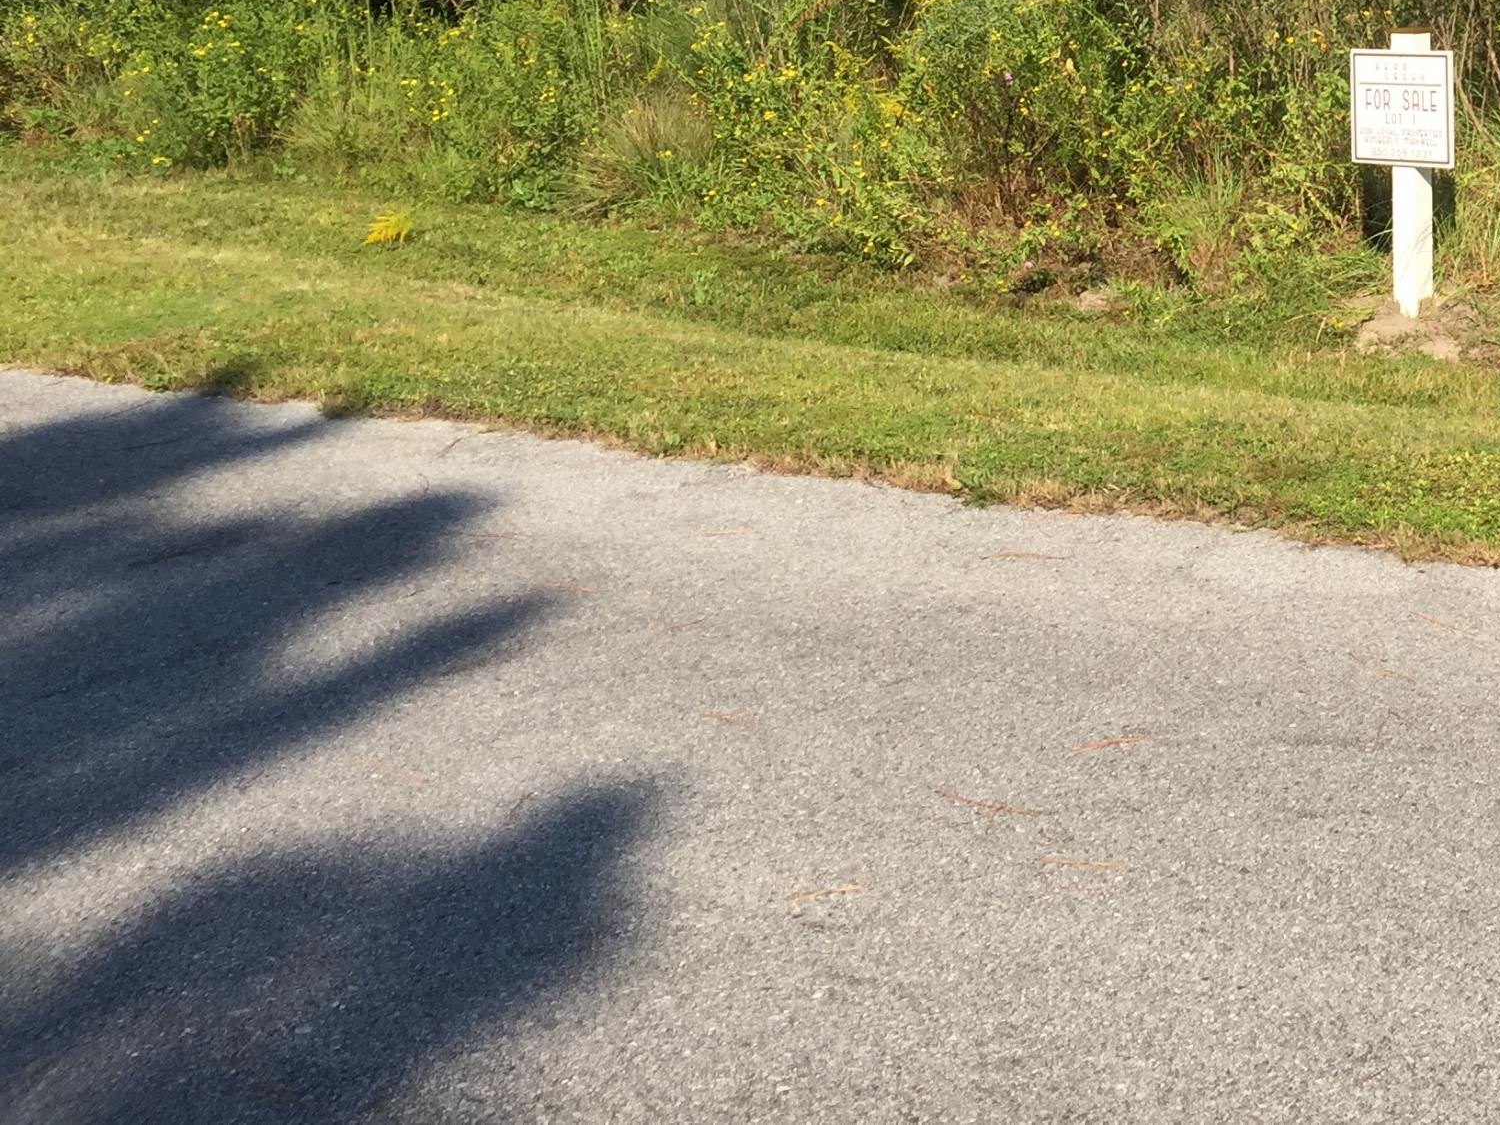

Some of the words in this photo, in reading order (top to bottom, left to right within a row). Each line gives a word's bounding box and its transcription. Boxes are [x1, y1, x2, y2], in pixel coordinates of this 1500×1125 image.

[1365, 88, 1391, 111] FOR
[1402, 89, 1438, 113] SALE
[1385, 113, 1403, 125] LOT
